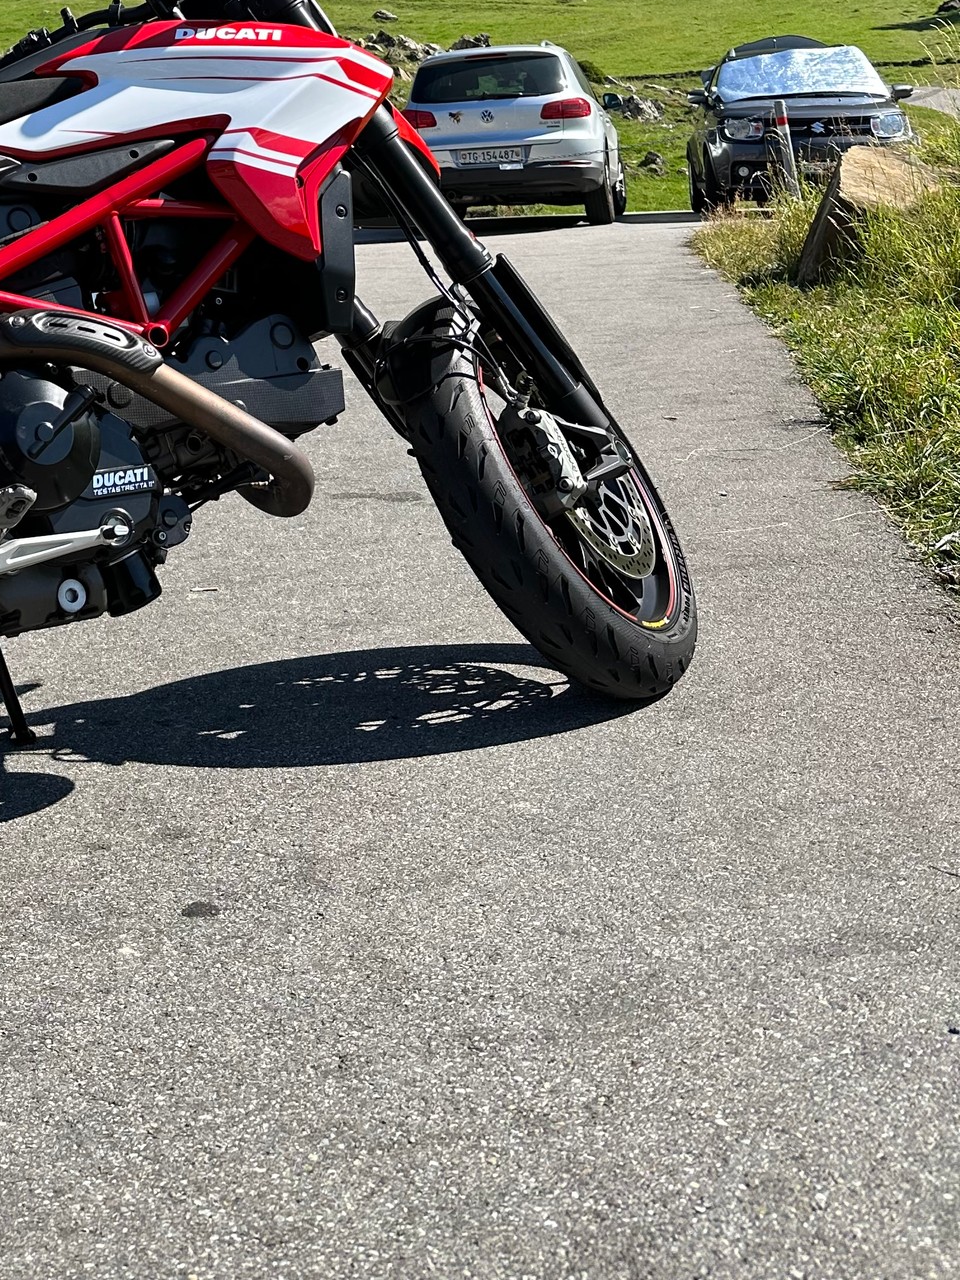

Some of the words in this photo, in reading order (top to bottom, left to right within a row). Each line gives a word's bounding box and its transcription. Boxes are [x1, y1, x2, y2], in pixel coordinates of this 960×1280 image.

[174, 27, 282, 41] DUCATI
[92, 467, 149, 489] DUCATI
[93, 481, 148, 496] TESTASTRETTA
